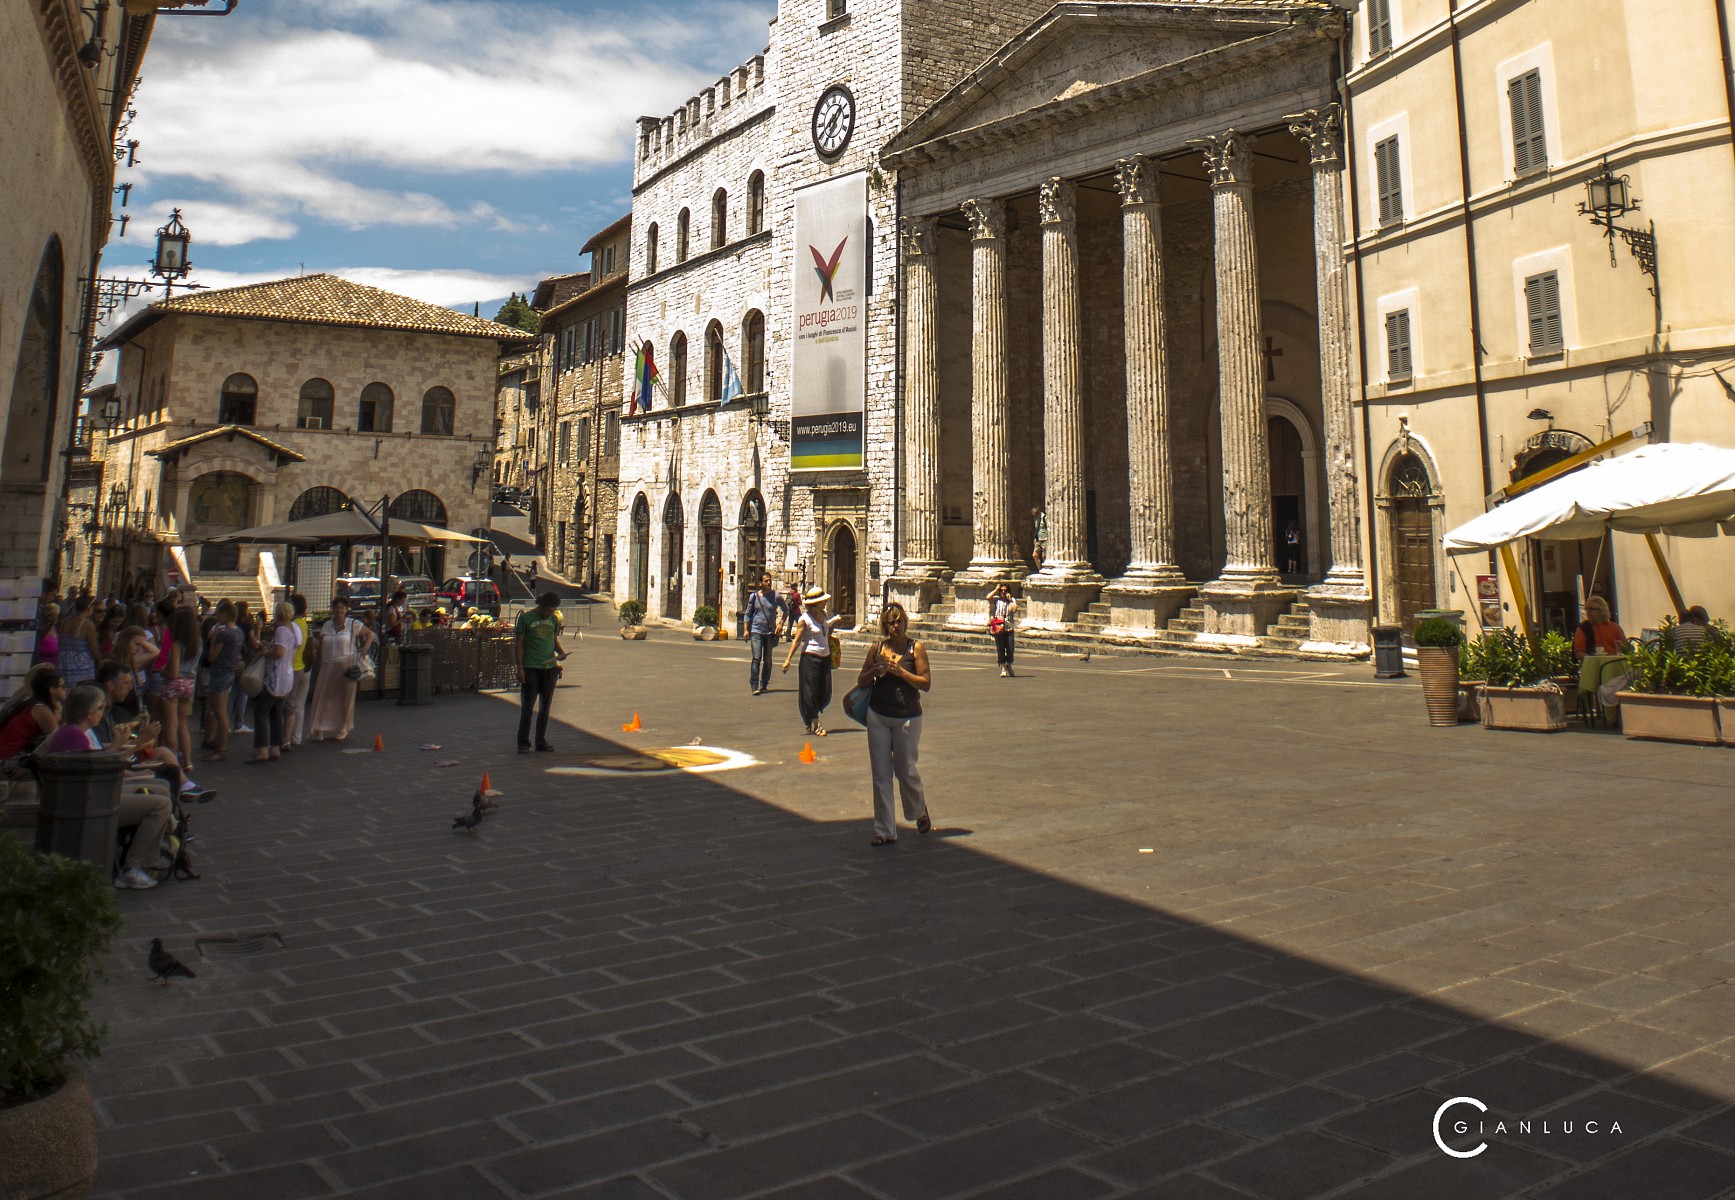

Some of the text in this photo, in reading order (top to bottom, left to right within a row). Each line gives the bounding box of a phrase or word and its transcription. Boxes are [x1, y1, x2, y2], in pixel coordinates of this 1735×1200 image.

[799, 305, 858, 331] perugia2019
[796, 421, 857, 437] www.perugia2019.eu
[1527, 432, 1567, 447] PIZZERIA
